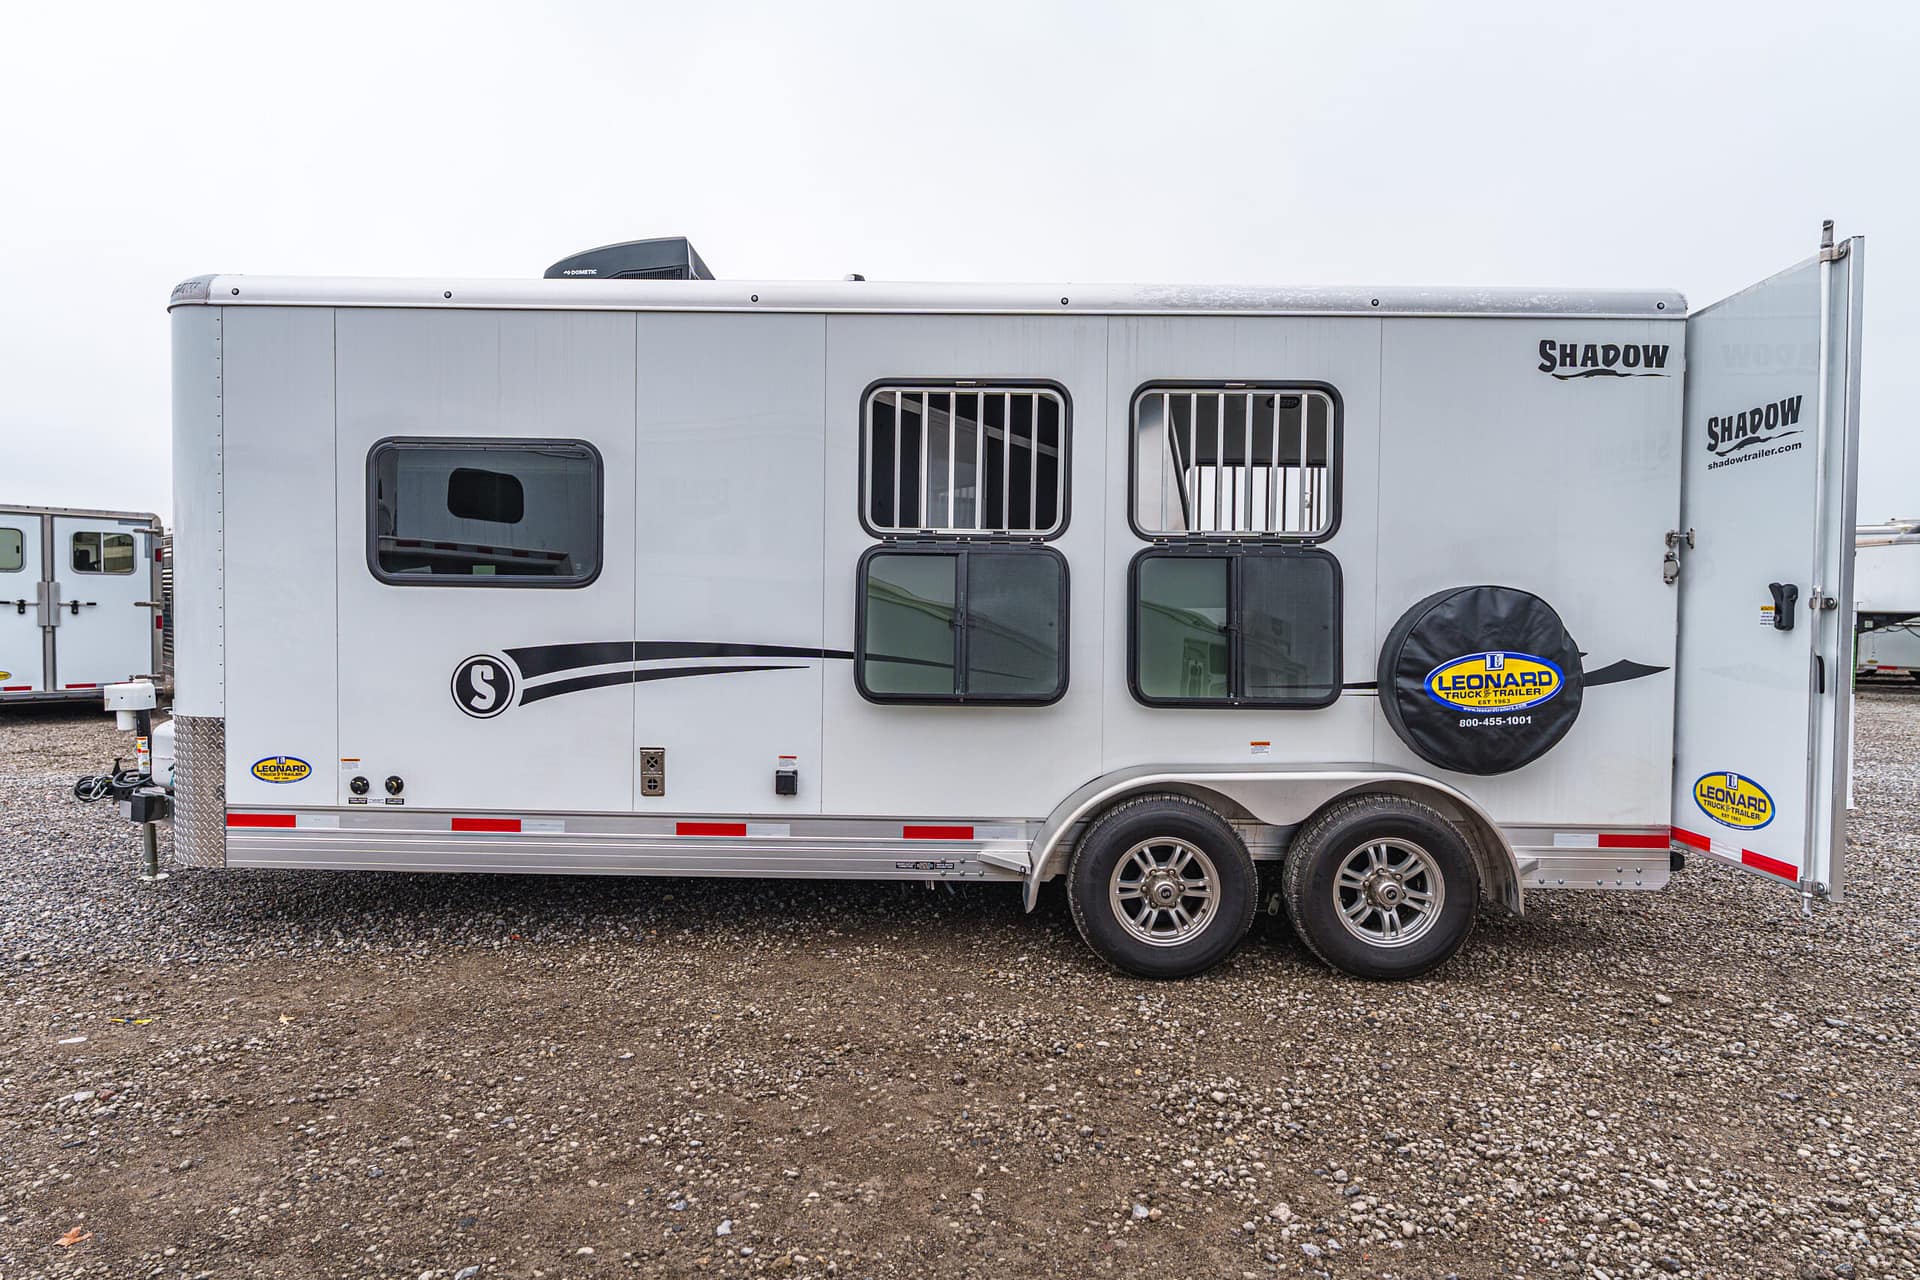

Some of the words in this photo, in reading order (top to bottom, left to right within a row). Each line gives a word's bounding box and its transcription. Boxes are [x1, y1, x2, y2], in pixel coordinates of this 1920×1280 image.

[1538, 339, 1670, 373] SHADOW
[1706, 394, 1803, 452] SHADOW
[1707, 441, 1802, 470] shadowtrailer.com
[470, 664, 496, 710] S
[1438, 670, 1553, 691] LEONARD
[1444, 690, 1482, 699] TRUCK
[1493, 687, 1541, 697] TRAILER
[1459, 715, 1532, 728] 800-455-1001
[256, 765, 306, 773] LEONARD
[1699, 783, 1767, 814] LEONARD
[1703, 799, 1726, 811] TRUCK
[1731, 806, 1761, 821] TRAILER
